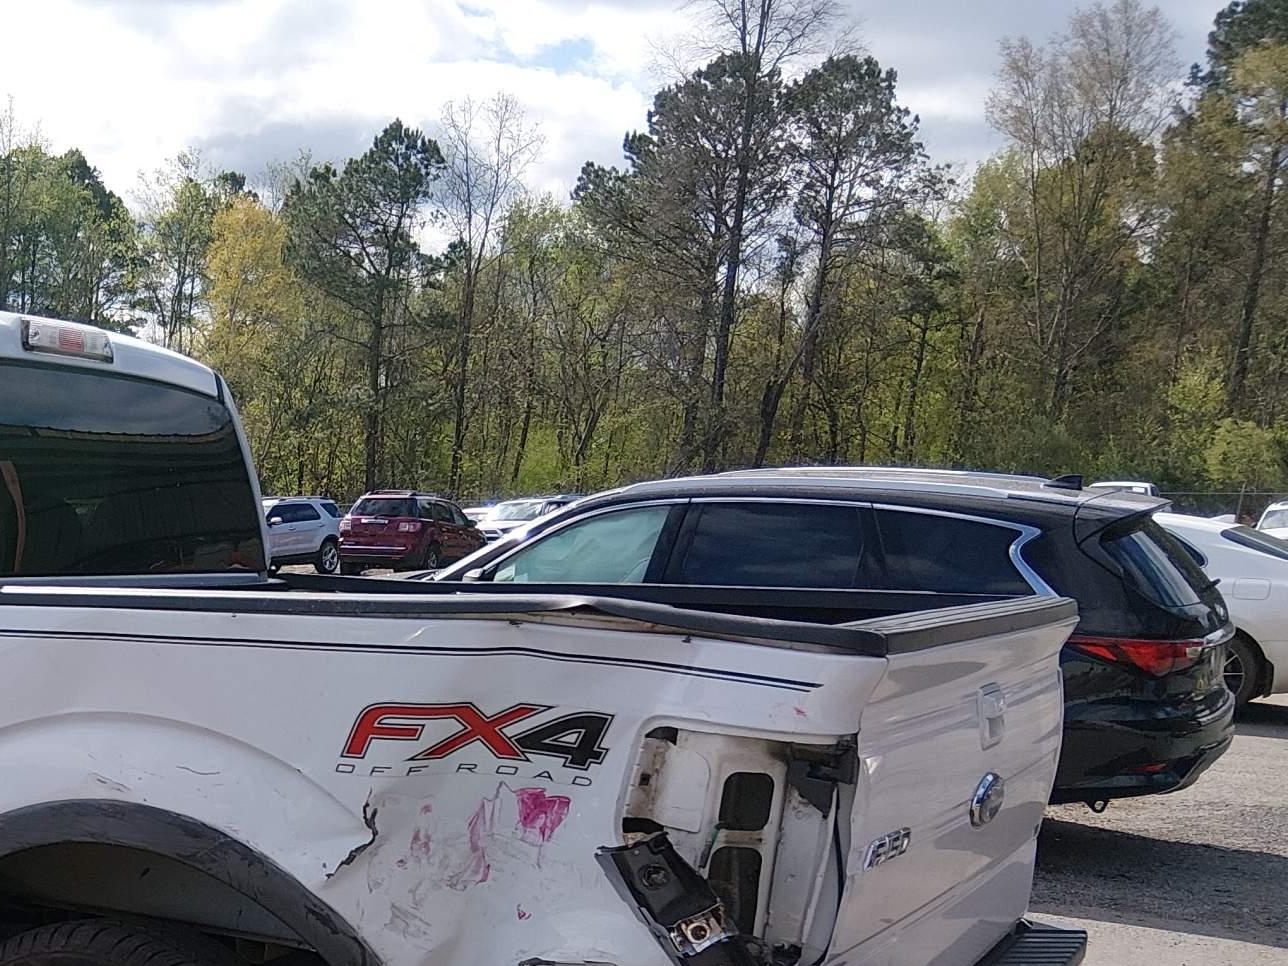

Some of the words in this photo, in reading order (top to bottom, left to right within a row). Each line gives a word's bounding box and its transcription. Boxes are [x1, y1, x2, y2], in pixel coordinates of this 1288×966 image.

[340, 702, 615, 771] FX4
[335, 763, 429, 776] OFF
[455, 763, 593, 787] ROAD
